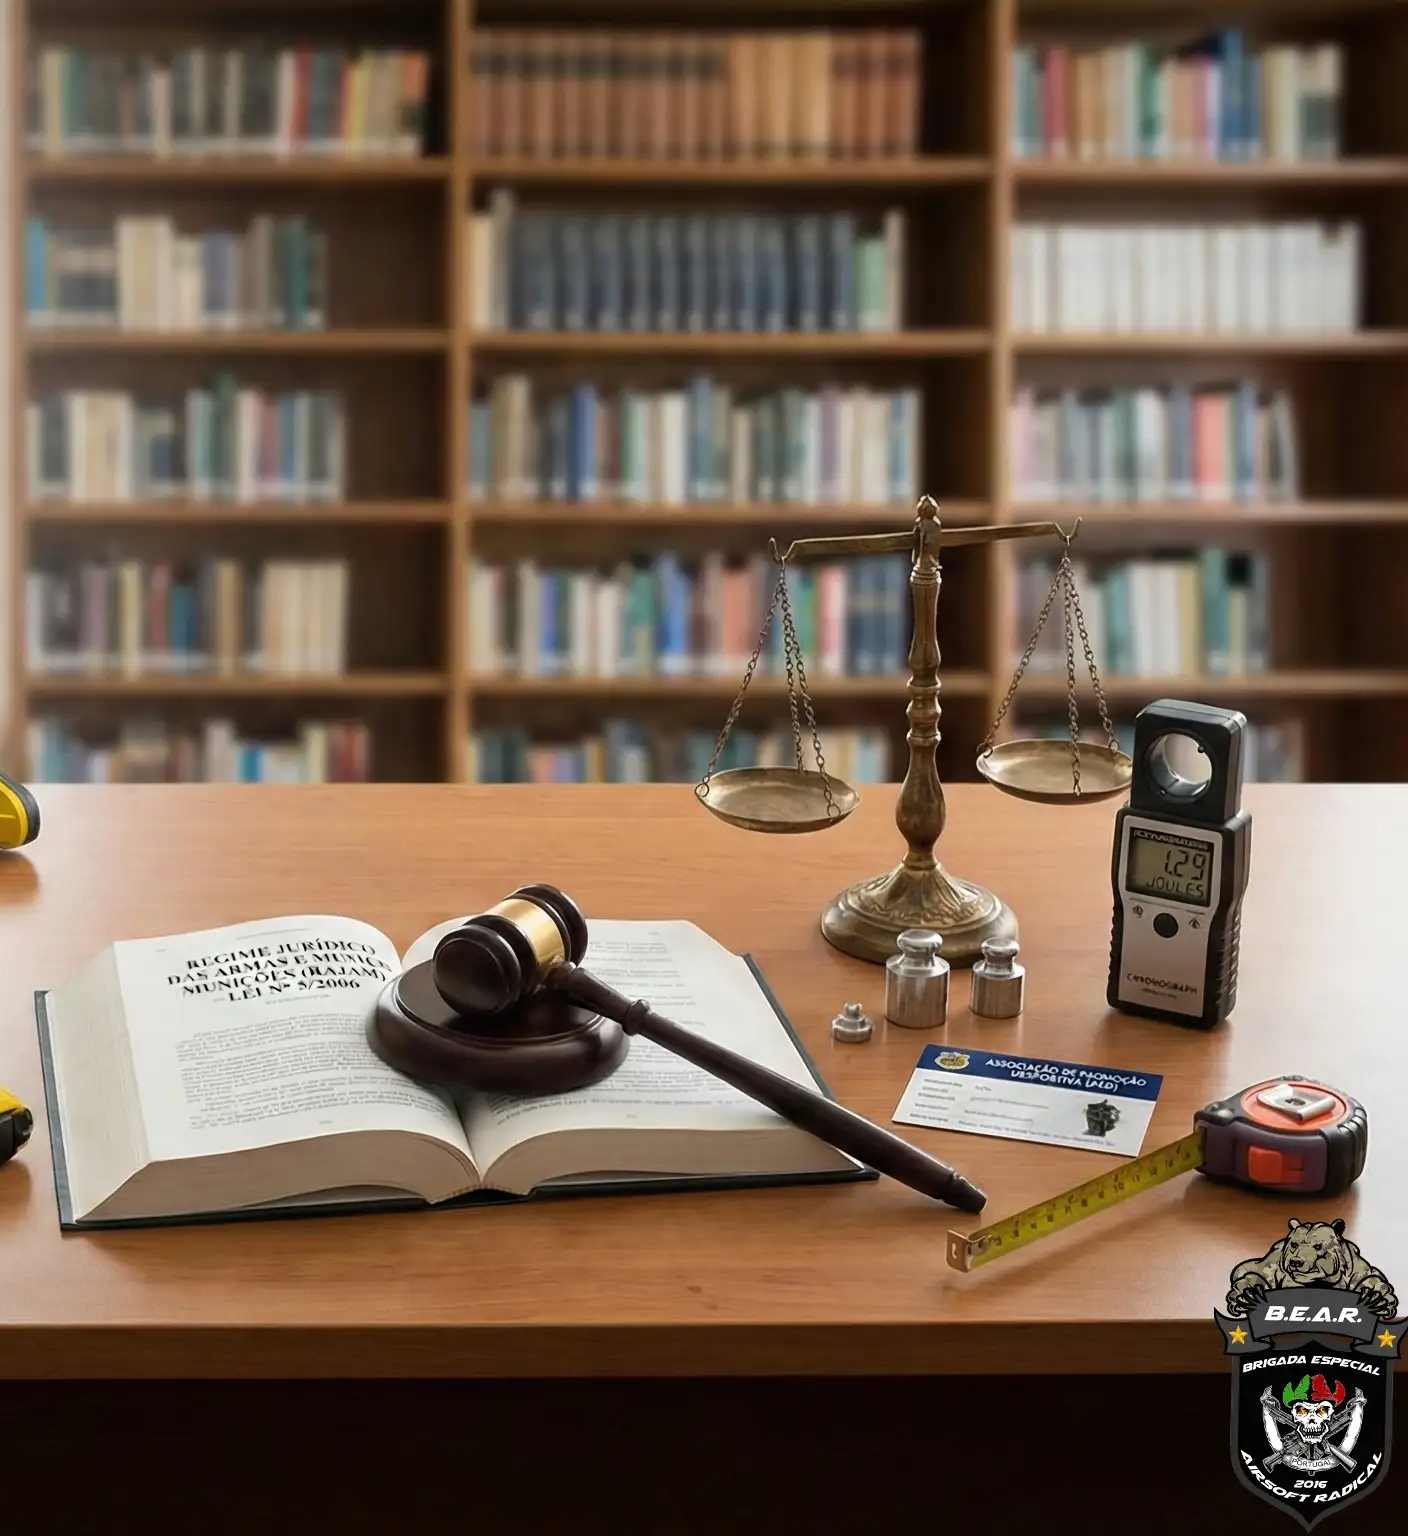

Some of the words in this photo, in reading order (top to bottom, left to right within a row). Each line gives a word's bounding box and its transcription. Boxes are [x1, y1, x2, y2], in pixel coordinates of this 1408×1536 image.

[1164, 849, 1205, 881] 1.29
[1146, 876, 1204, 898] JOULES
[186, 946, 272, 969] REGIME
[277, 938, 376, 955] JURÍDICO
[167, 969, 208, 985] DAS
[214, 957, 288, 977] ARMAS
[294, 955, 308, 965] E
[228, 986, 263, 1001] LEI
[297, 978, 361, 992] 5/2006
[1061, 1068, 1078, 1077] DE
